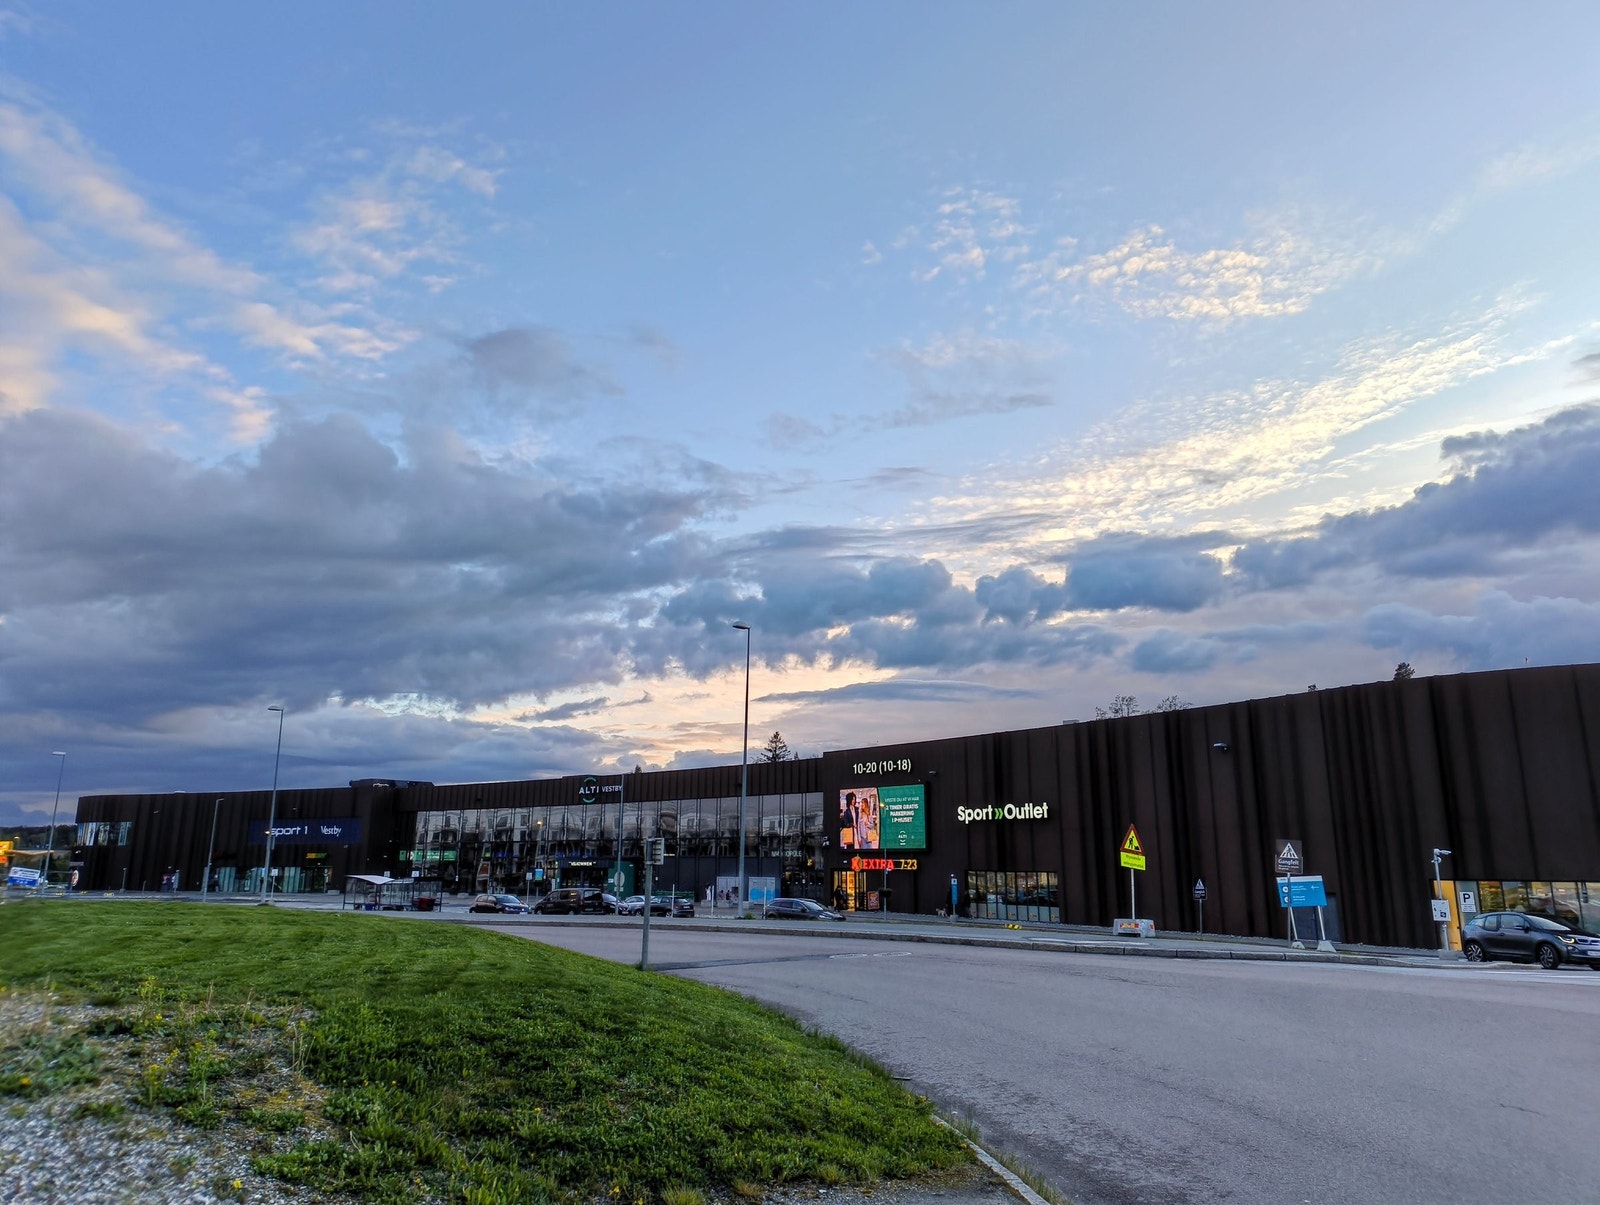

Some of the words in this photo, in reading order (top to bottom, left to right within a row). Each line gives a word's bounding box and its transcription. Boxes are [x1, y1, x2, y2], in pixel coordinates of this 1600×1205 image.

[853, 761, 877, 774] 10-20
[879, 758, 911, 775] (10-18)
[579, 786, 600, 794] ALTI
[957, 804, 993, 824] Sport
[1004, 802, 1049, 819] Outlet
[271, 826, 301, 837] sport
[304, 826, 308, 835] 1
[321, 825, 342, 837] Vestby
[862, 858, 895, 870] EXTRA
[900, 859, 918, 870] 7-23
[1463, 893, 1470, 903] P
